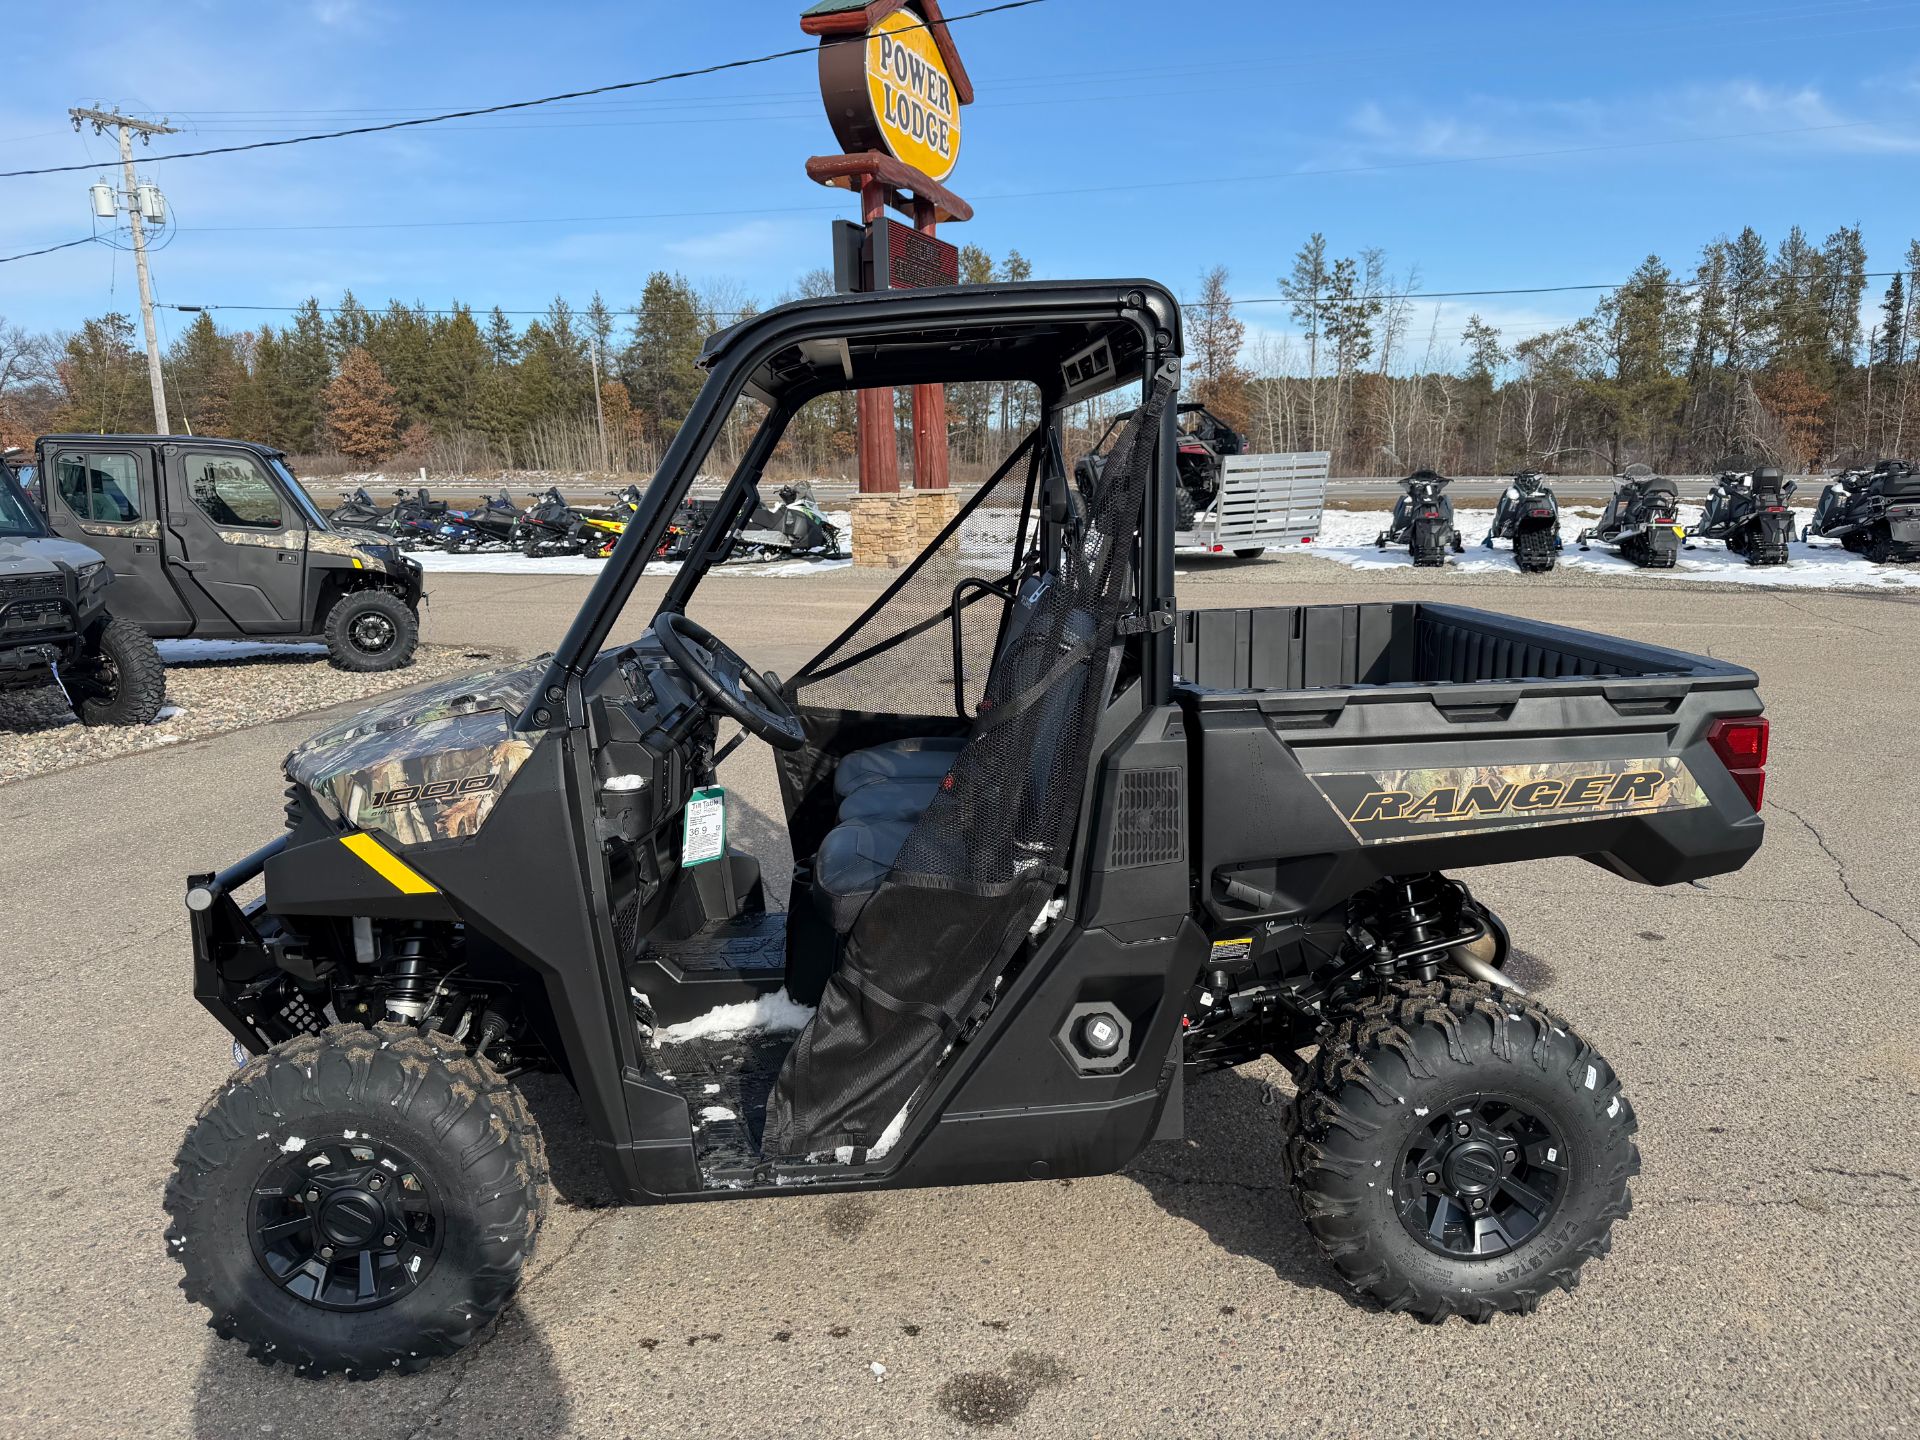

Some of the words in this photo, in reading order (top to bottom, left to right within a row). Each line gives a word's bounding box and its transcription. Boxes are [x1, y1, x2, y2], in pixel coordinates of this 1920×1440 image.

[879, 30, 951, 115] POWER
[883, 84, 950, 157] LODGE
[372, 773, 499, 809] 1000
[1349, 769, 1667, 823] RANGER
